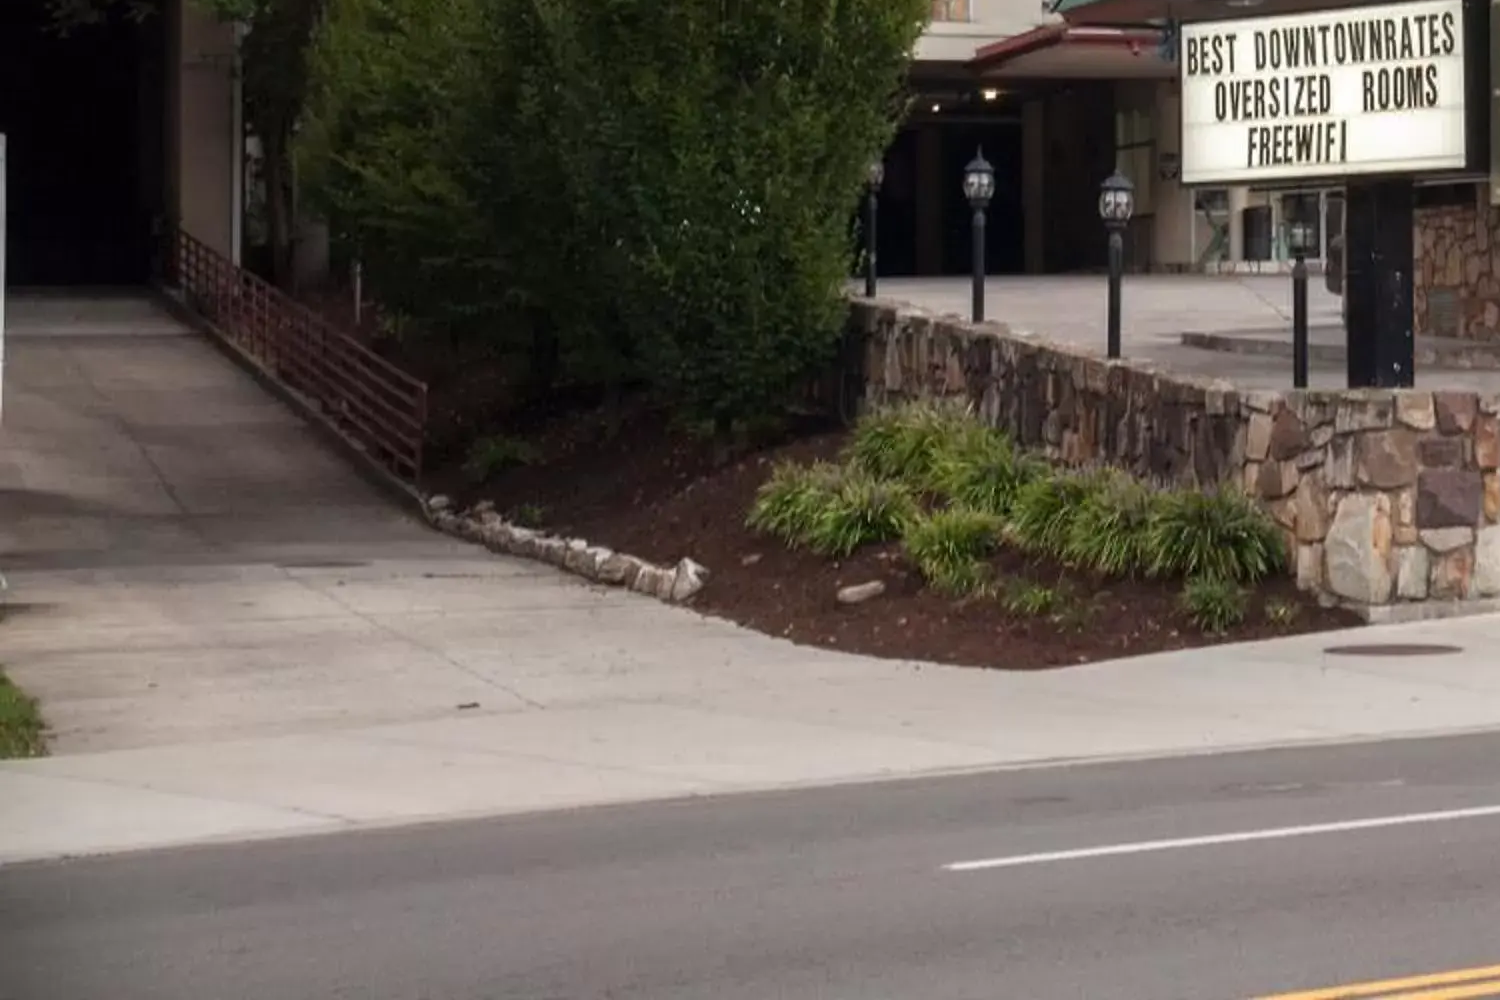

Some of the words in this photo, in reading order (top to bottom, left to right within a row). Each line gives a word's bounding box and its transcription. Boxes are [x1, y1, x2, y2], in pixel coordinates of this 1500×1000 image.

[1187, 34, 1236, 75] BEST
[1215, 73, 1331, 121] OVERSIZED
[1363, 64, 1438, 111] ROOMS
